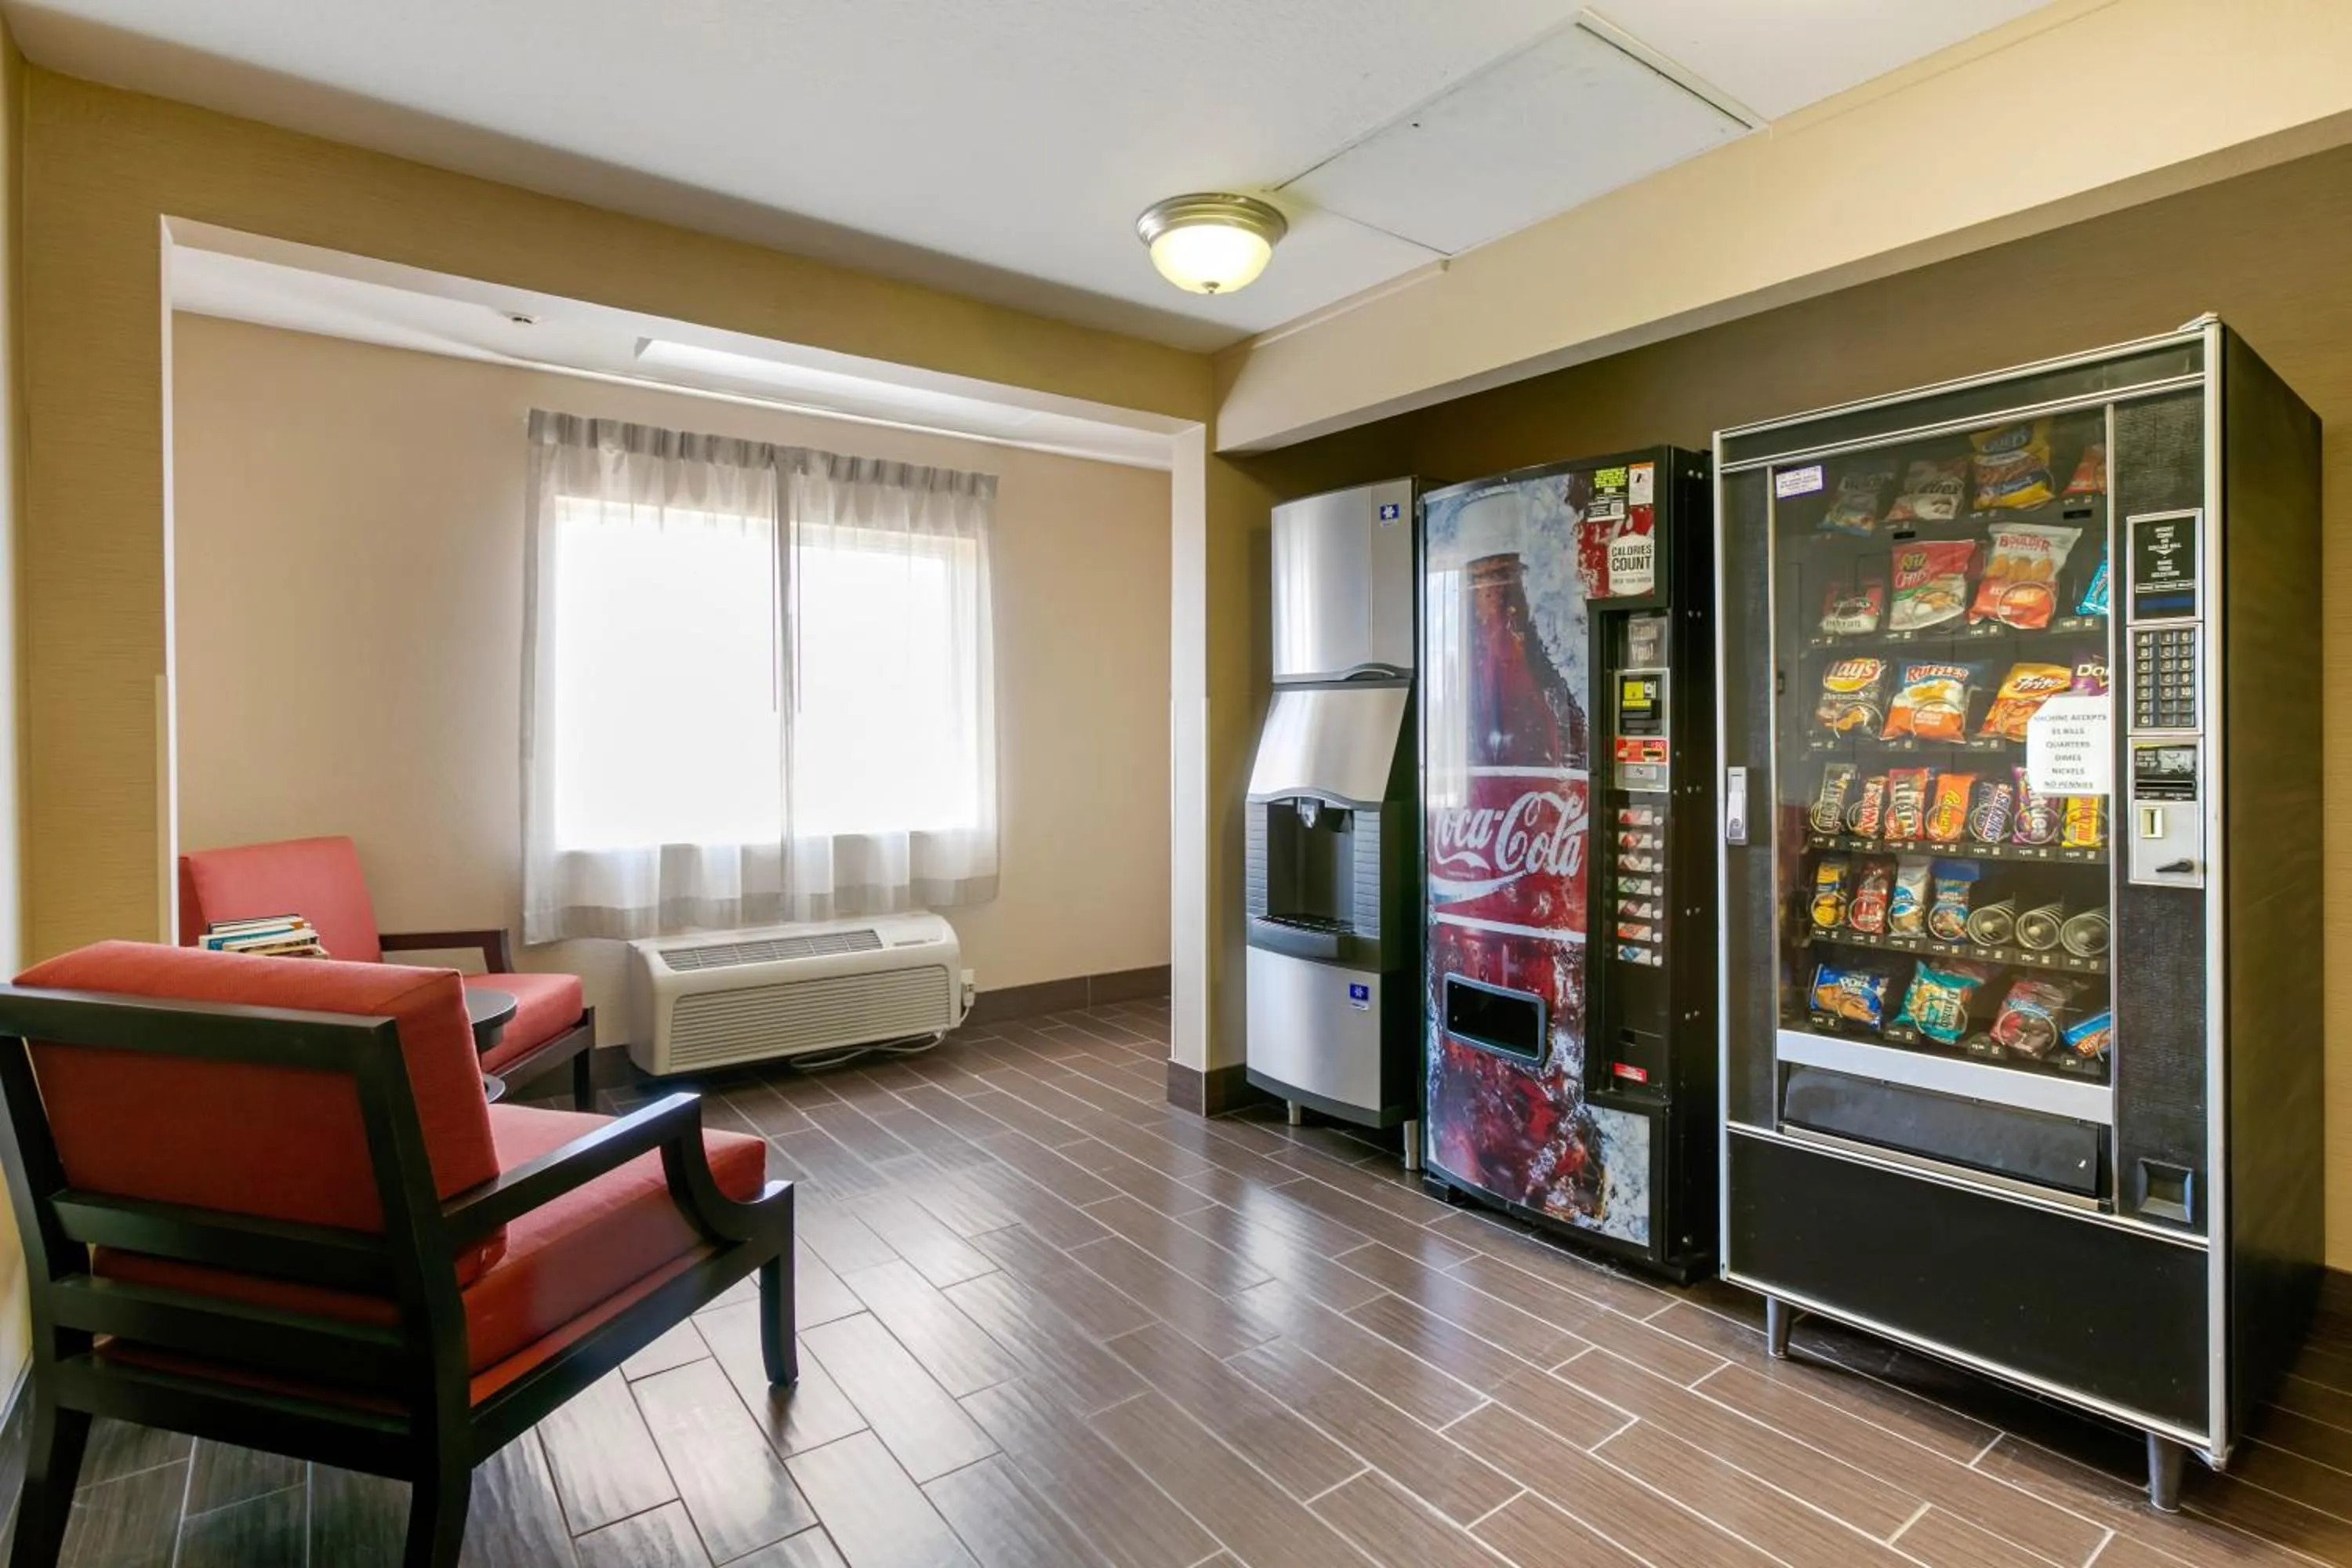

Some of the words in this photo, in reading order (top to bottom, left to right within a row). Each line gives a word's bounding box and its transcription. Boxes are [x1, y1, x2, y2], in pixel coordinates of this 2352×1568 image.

[1611, 544, 1652, 557] CALORIES
[2000, 534, 2051, 553] BOULDER
[1611, 557, 1651, 572] COUNT
[1433, 791, 1588, 877] Coca-Cola
